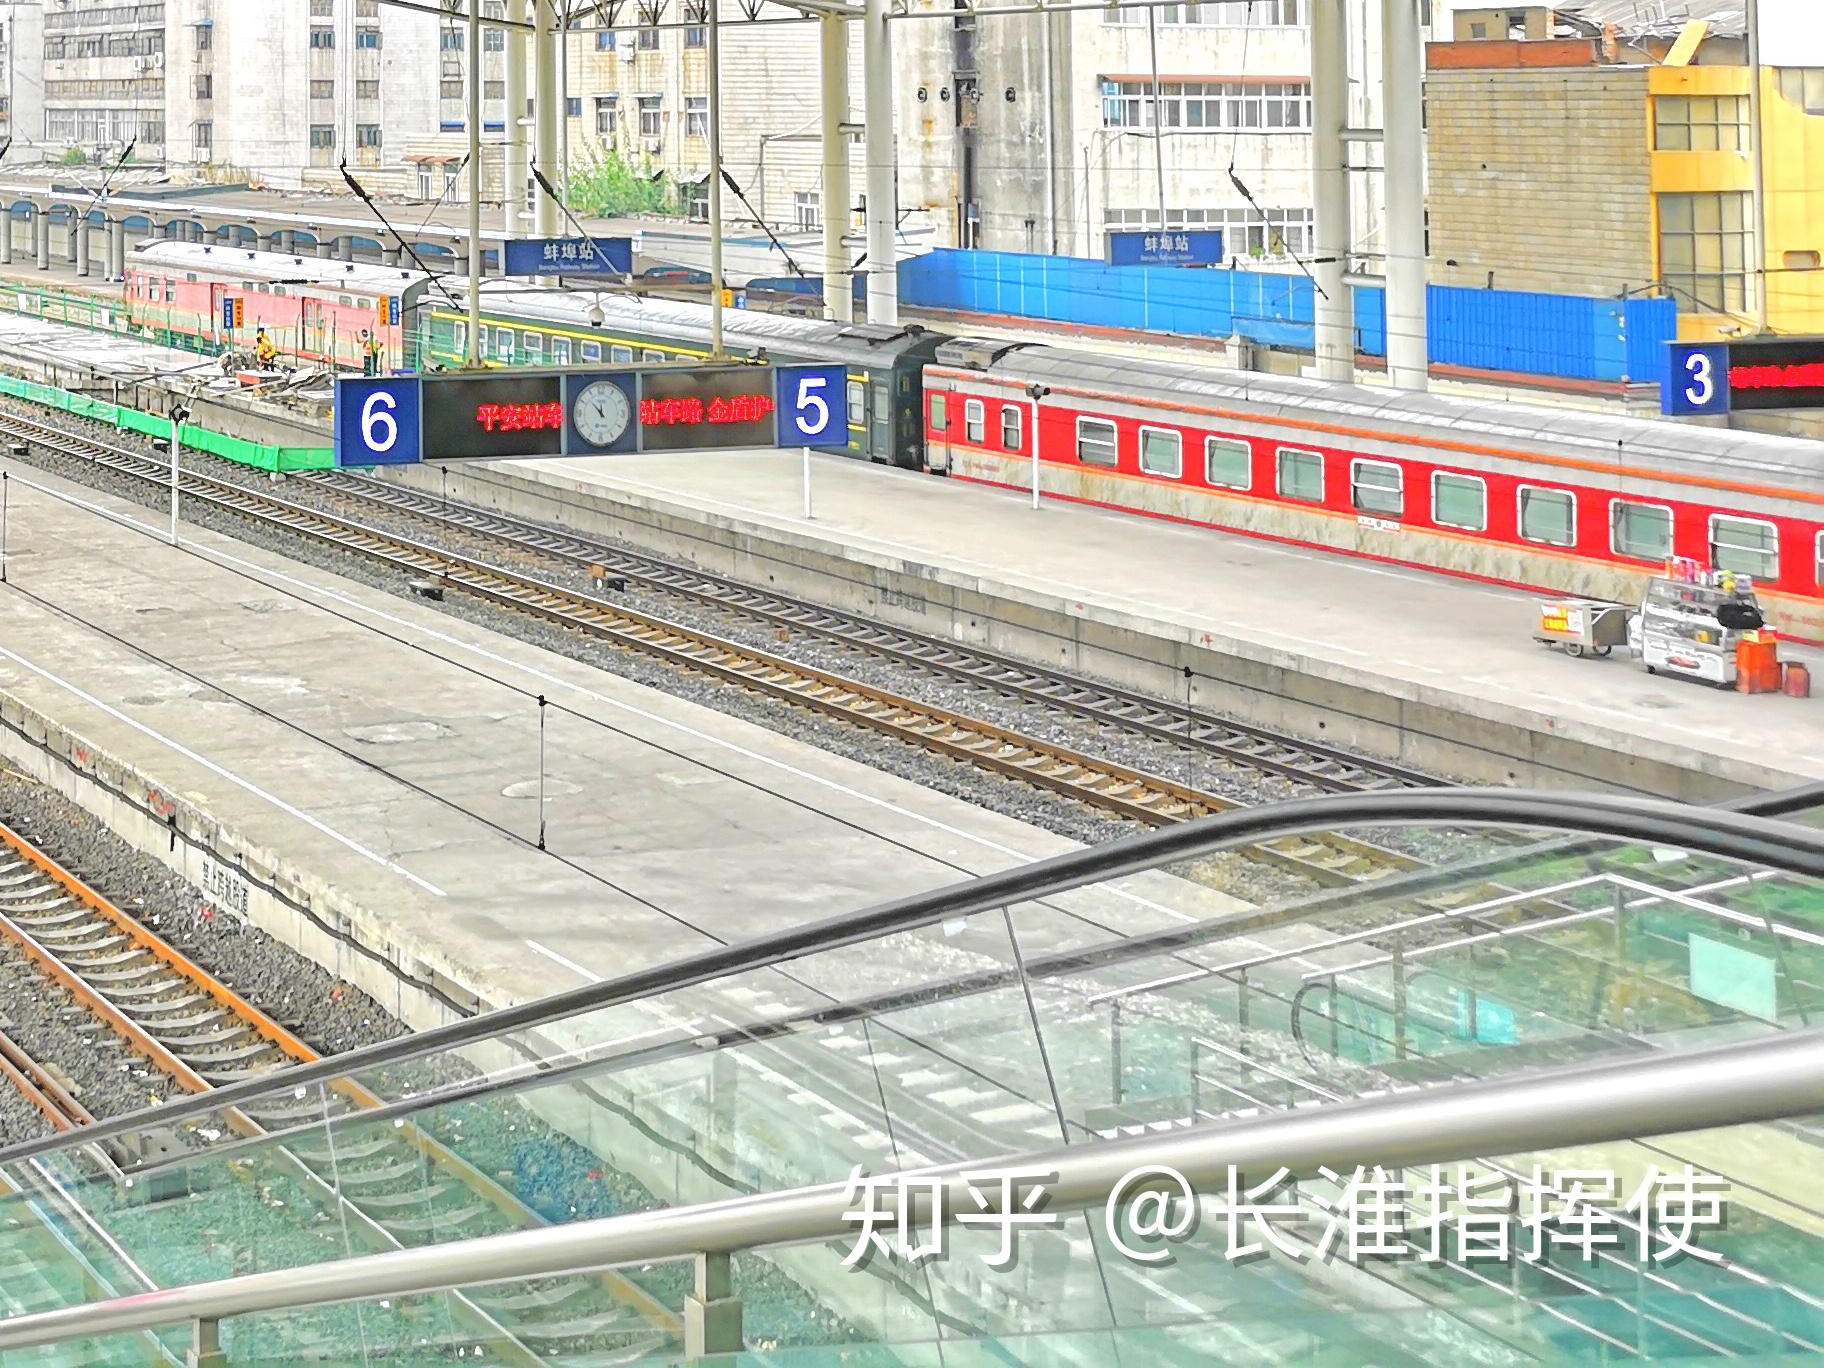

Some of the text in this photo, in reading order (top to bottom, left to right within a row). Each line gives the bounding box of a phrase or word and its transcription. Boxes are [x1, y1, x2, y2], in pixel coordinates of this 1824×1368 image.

[543, 242, 594, 261] 蚌埠站
[1685, 353, 1714, 405] 3
[361, 392, 398, 452] 6
[796, 378, 829, 435] 5
